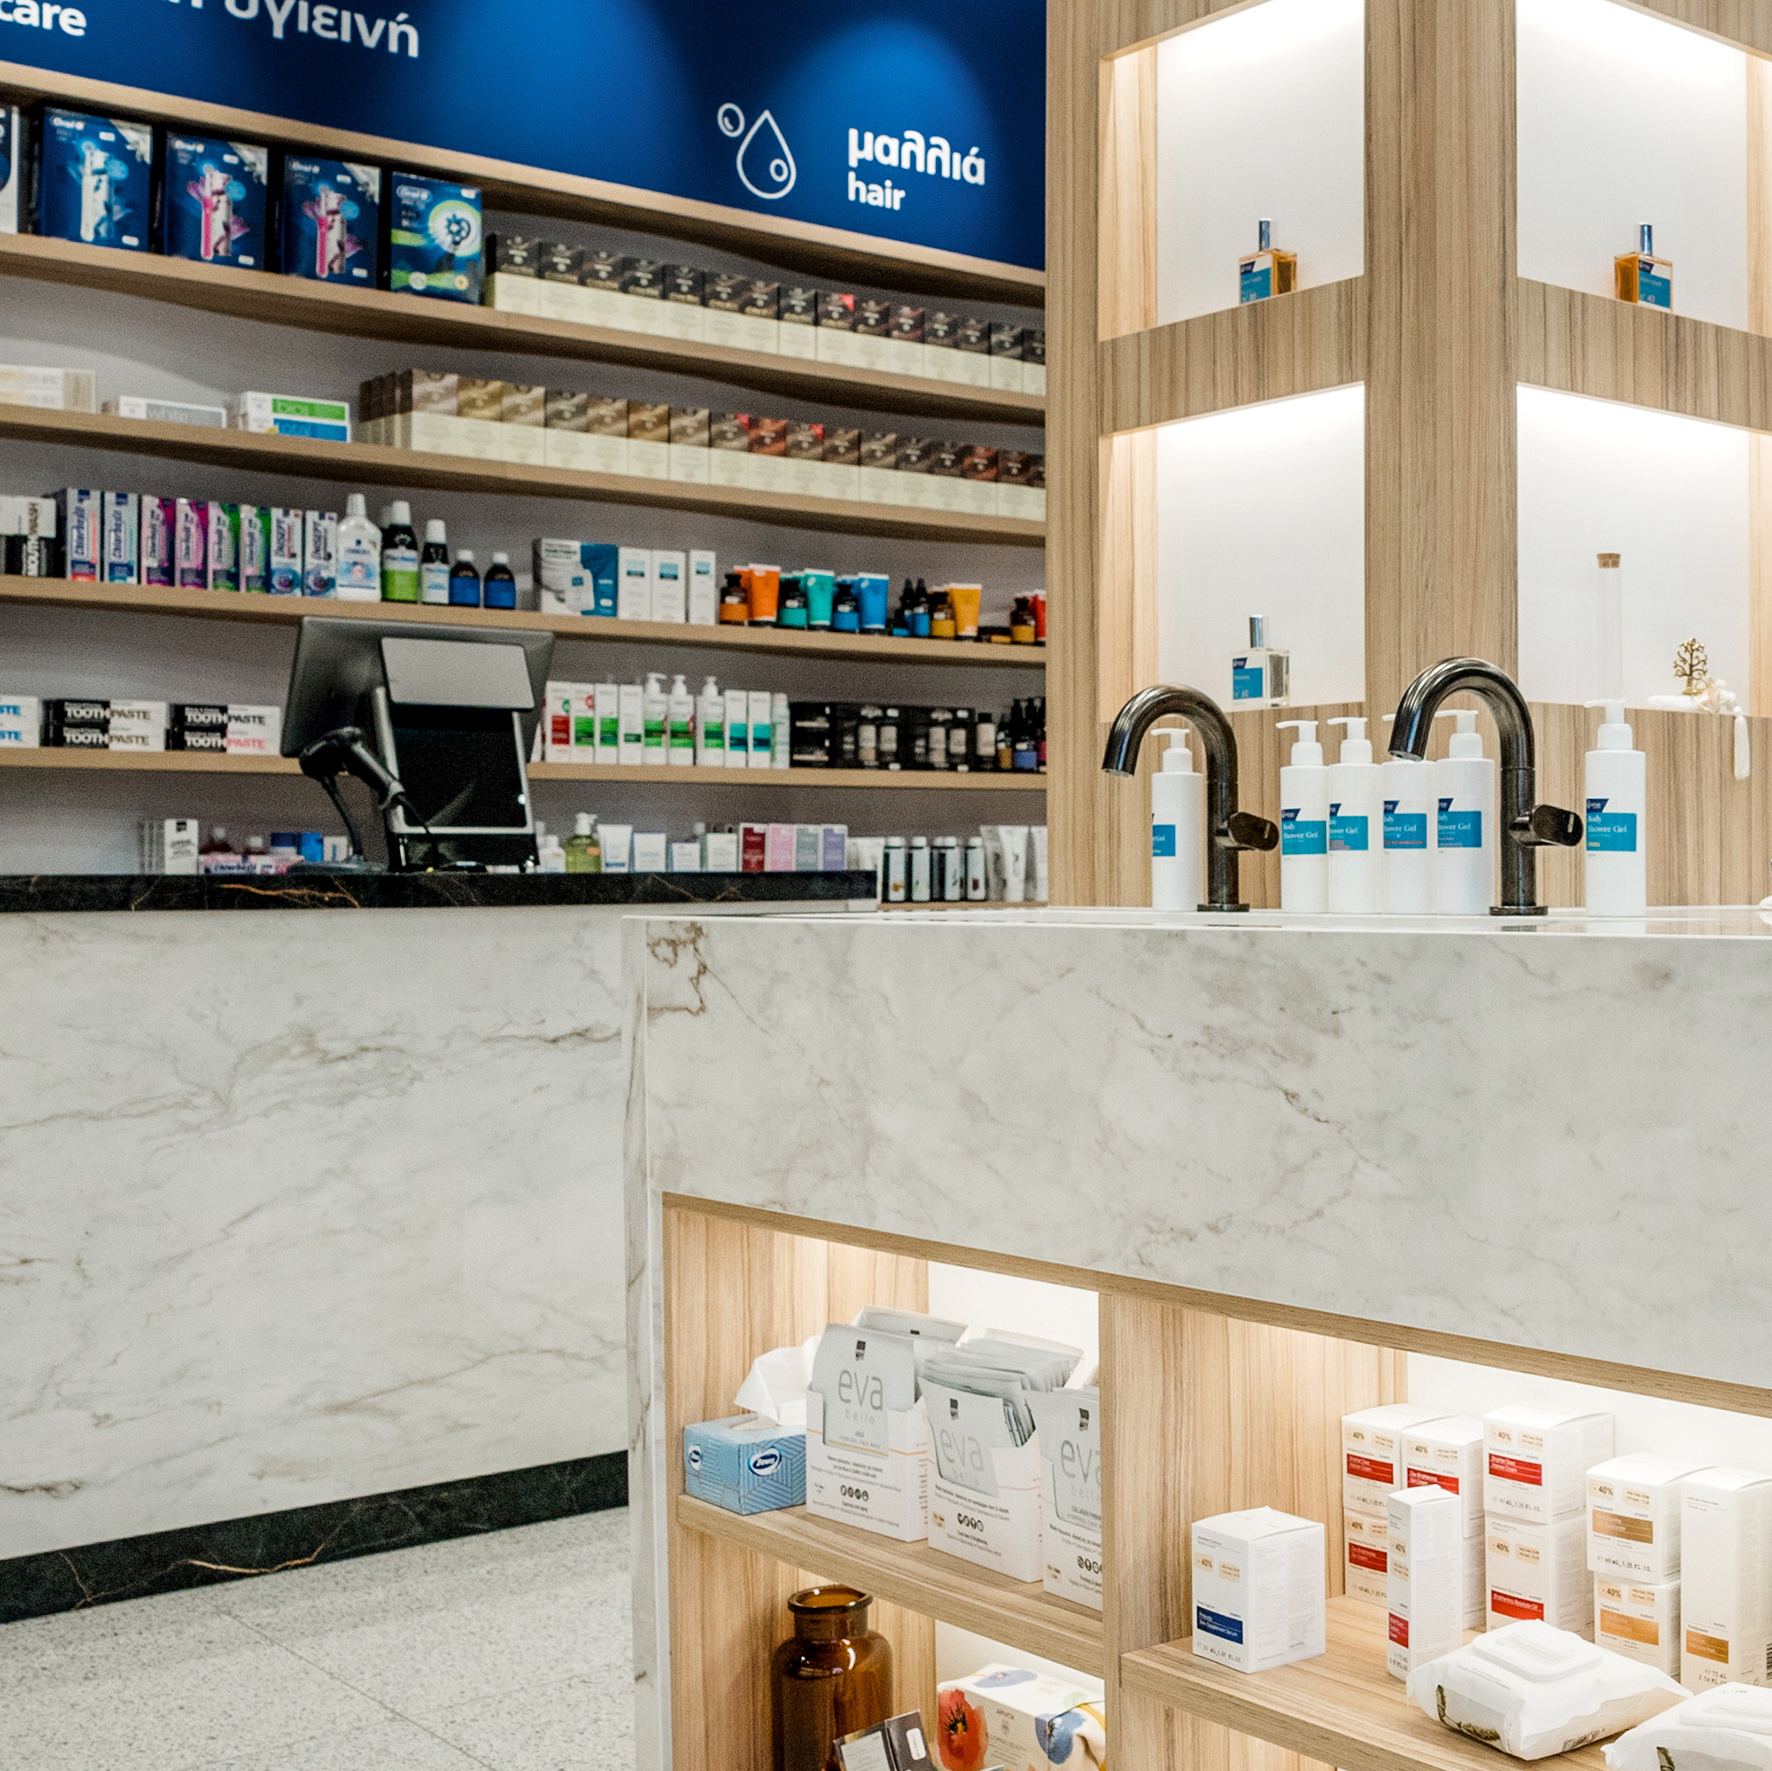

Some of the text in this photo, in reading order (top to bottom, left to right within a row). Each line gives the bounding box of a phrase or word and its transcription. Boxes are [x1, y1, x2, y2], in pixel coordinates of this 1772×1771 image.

[848, 127, 986, 186] μαλλιά
[847, 170, 906, 211] hair
[838, 1369, 883, 1411] eva
